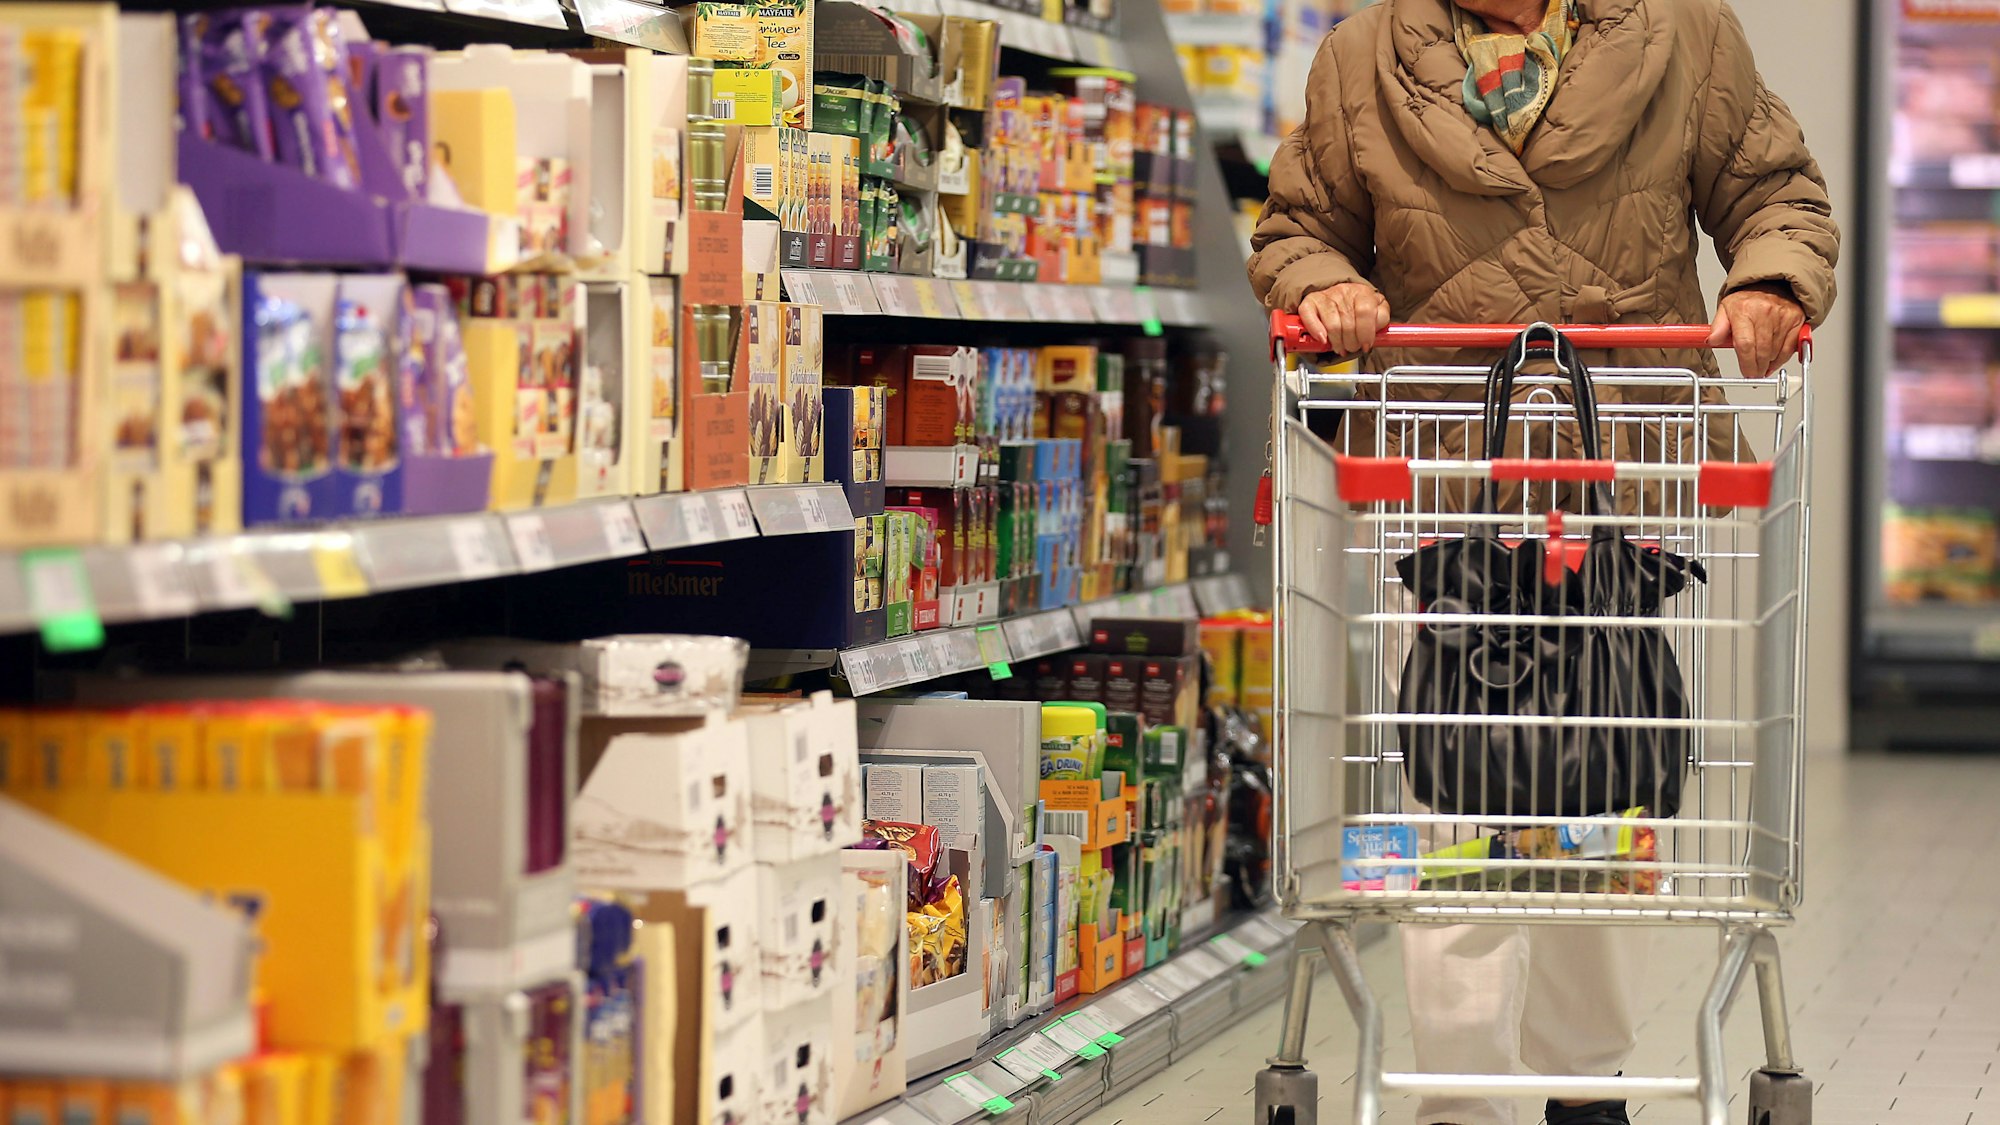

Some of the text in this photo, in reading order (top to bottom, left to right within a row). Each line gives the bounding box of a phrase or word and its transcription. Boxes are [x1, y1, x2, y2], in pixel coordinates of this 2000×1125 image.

[759, 8, 793, 16] MAYFAIR
[763, 36, 787, 48] Tee
[824, 87, 848, 96] JACOBS
[820, 102, 847, 112] Krönung
[628, 572, 724, 596] Meßmer
[1348, 831, 1383, 846] Speise
